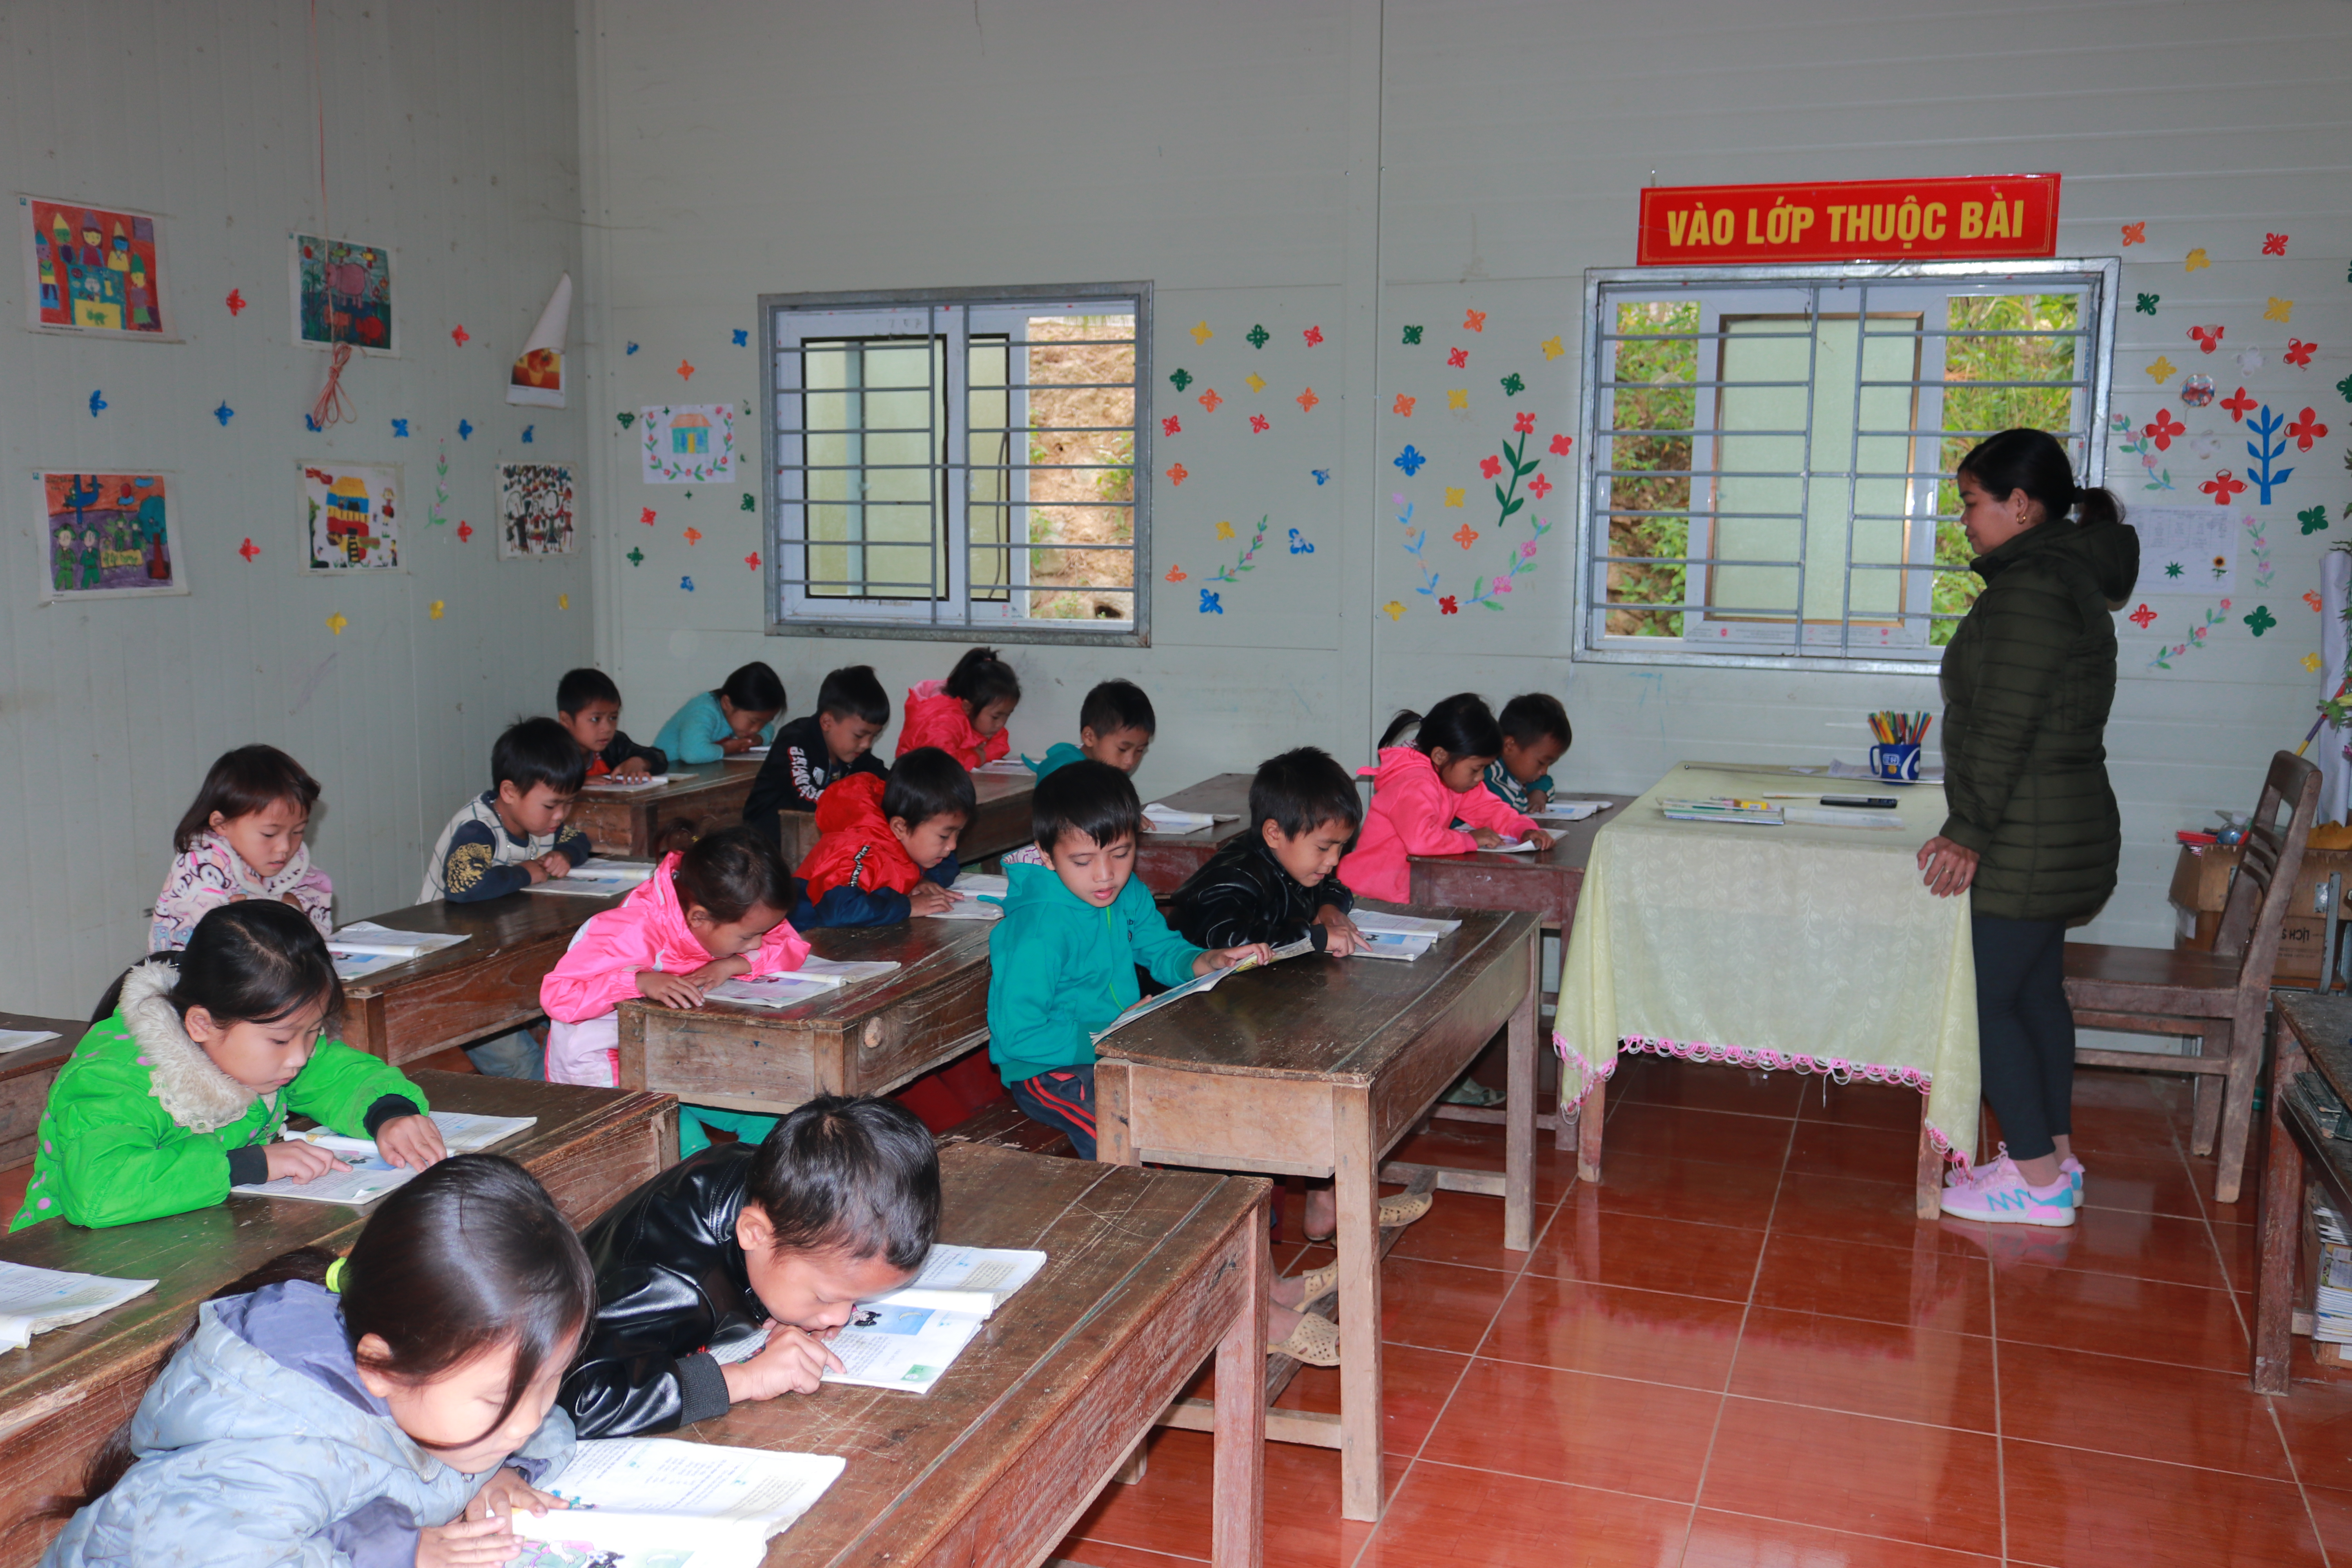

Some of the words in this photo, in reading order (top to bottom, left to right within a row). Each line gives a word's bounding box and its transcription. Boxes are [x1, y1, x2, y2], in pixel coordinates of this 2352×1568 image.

[1667, 202, 1735, 246] VÀO
[1747, 196, 1814, 244] LỚP
[1827, 195, 1947, 249] THUỘC
[1960, 192, 2024, 239] BÀI
